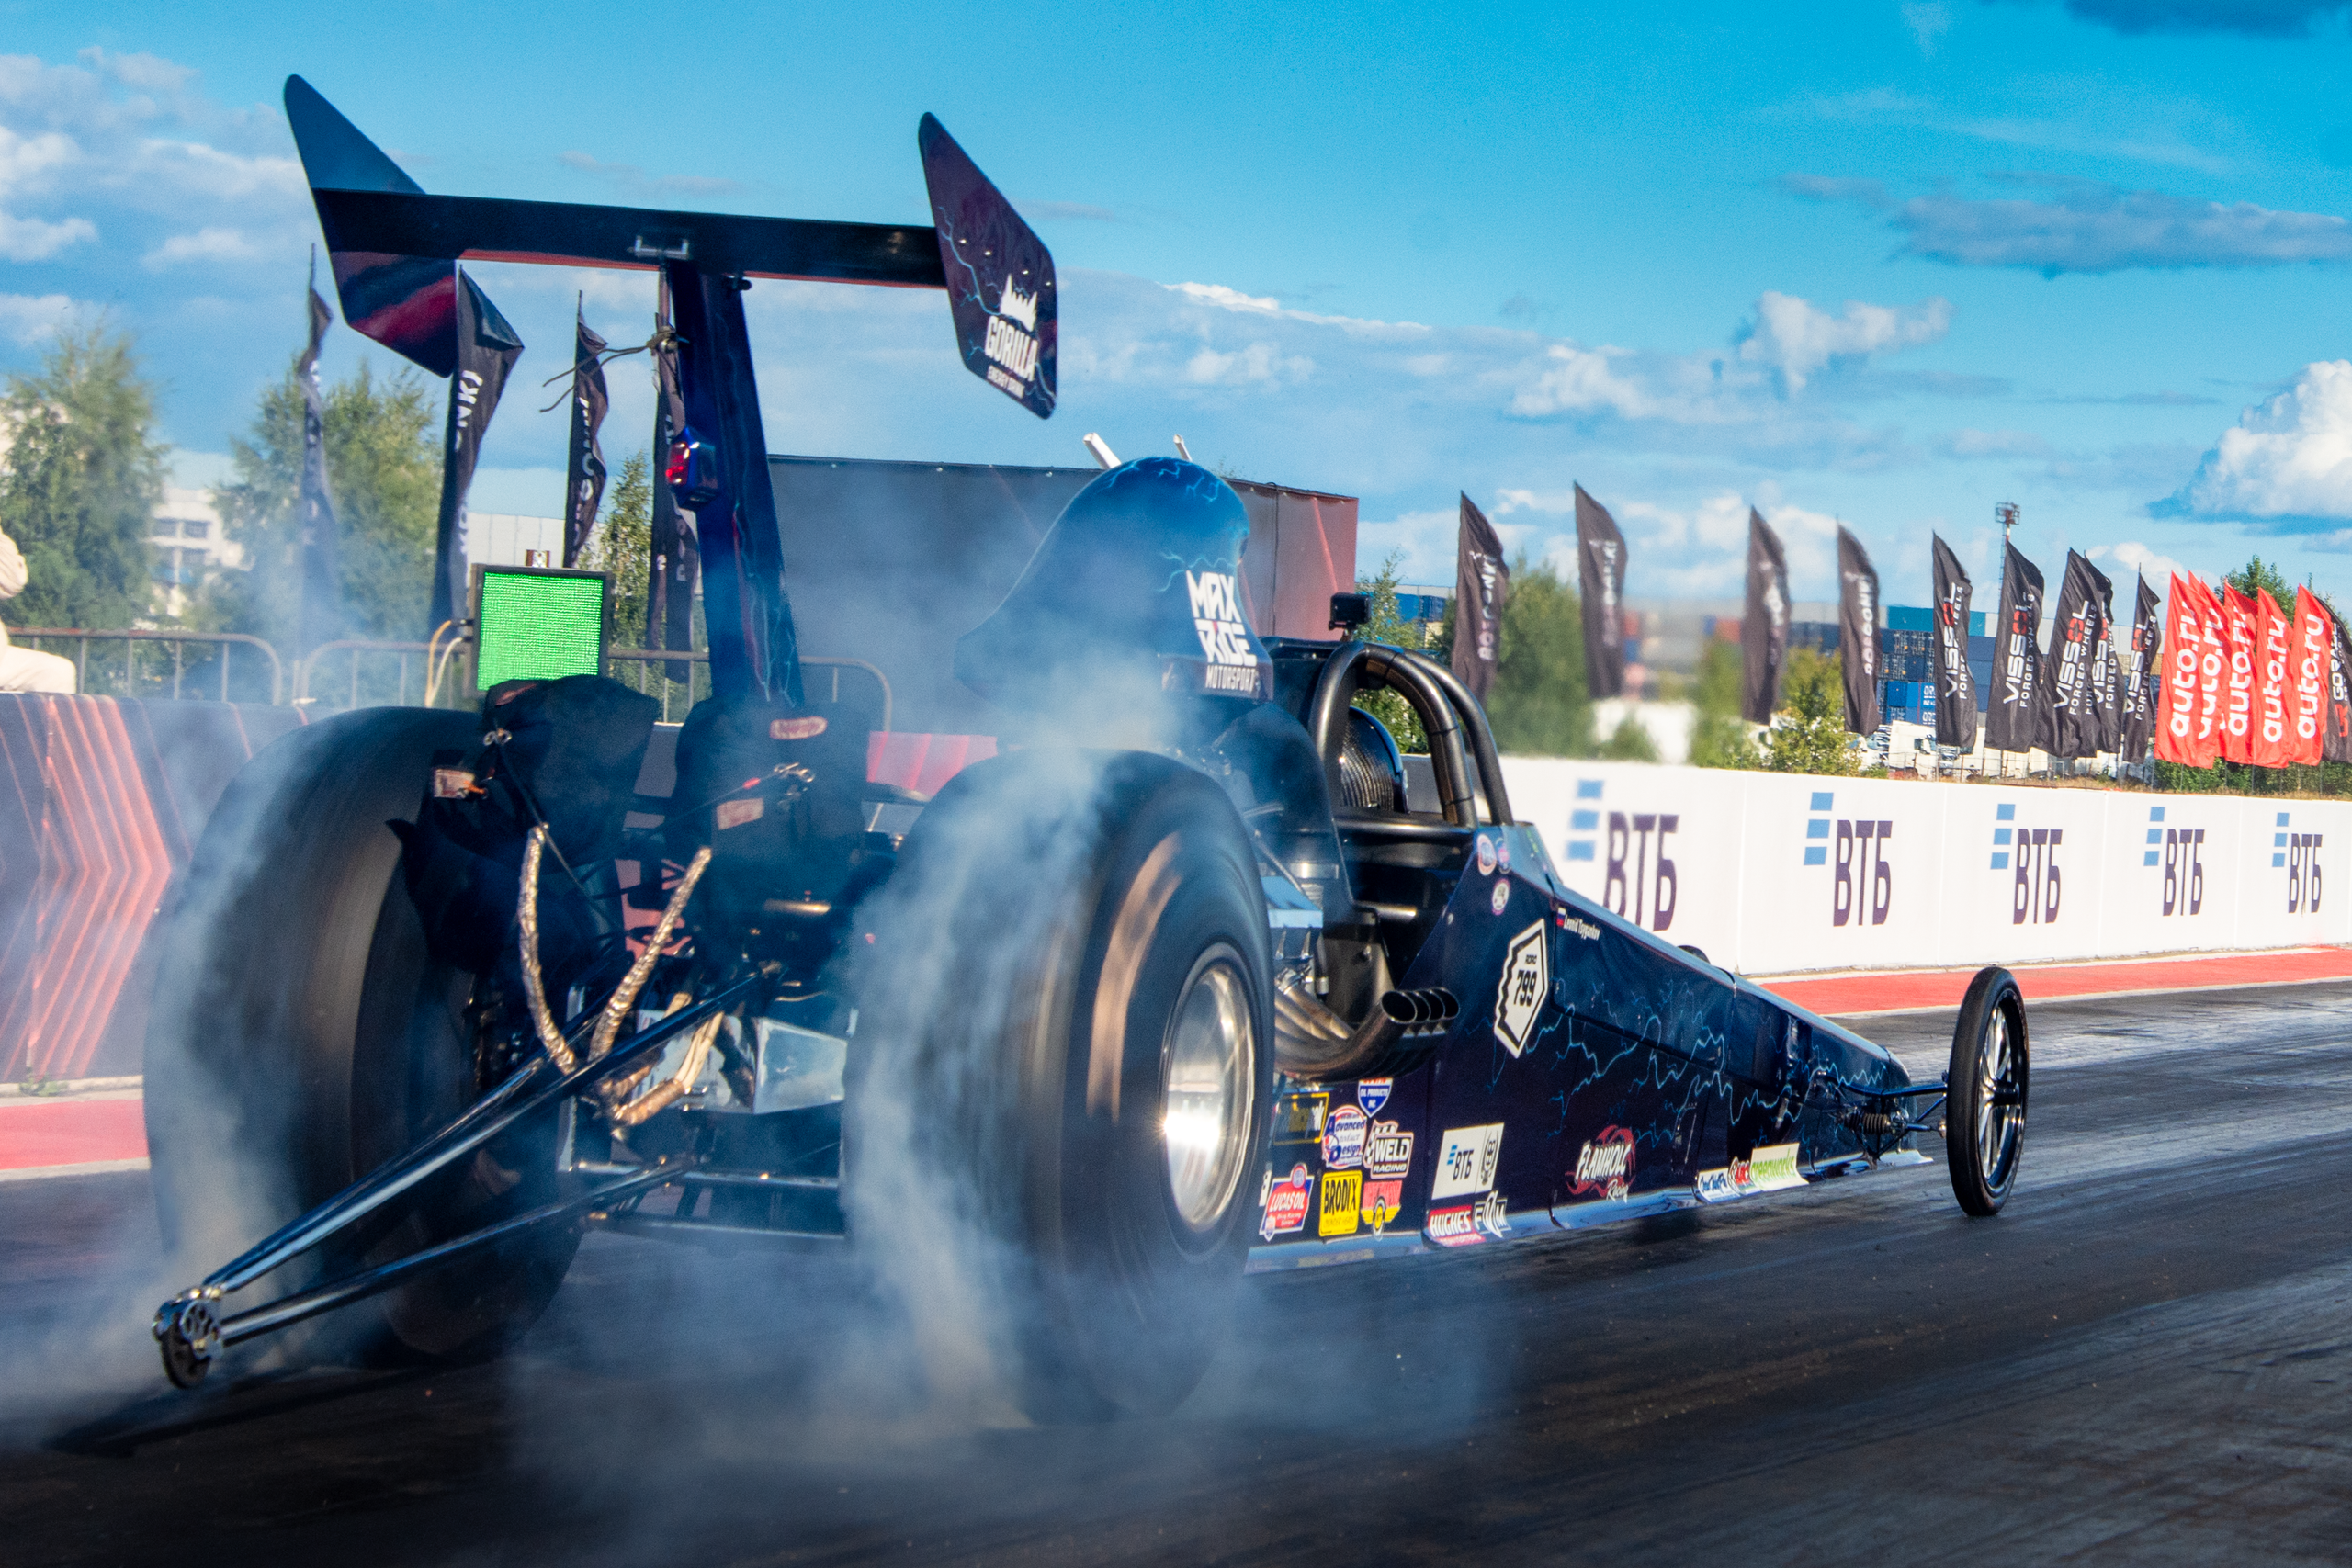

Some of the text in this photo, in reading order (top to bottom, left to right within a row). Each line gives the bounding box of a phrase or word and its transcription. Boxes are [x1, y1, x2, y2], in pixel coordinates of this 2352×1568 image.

[984, 315, 1038, 381] GORILLA
[1185, 570, 1242, 623] MAX
[1205, 664, 1256, 693] MOTORSPORT
[2053, 600, 2089, 708] VISSOL
[2069, 604, 2098, 716] FORGED WHEELS
[2262, 615, 2288, 743] auto.ru
[2297, 613, 2324, 739] auto.ru
[2019, 654, 2034, 708] FORGED
[2105, 658, 2118, 710] FORGED
[1603, 811, 1680, 931] ВТБ
[1833, 819, 1894, 927] ВТБ
[2013, 829, 2063, 924] ВТБ
[2163, 829, 2205, 917] ВТБ
[2288, 833, 2323, 914] ВТБ
[1513, 969, 1537, 1007] 799
[1326, 1115, 1365, 1136] Advanced
[1374, 1138, 1410, 1163] WELD
[1329, 1145, 1361, 1163] Design
[1373, 1162, 1408, 1173] RACING
[1453, 1149, 1474, 1181] ВТБ
[1269, 1191, 1306, 1213] LUCAS OIL
[1324, 1178, 1359, 1215] BRODIX
[1430, 1210, 1472, 1237] HUGHES
